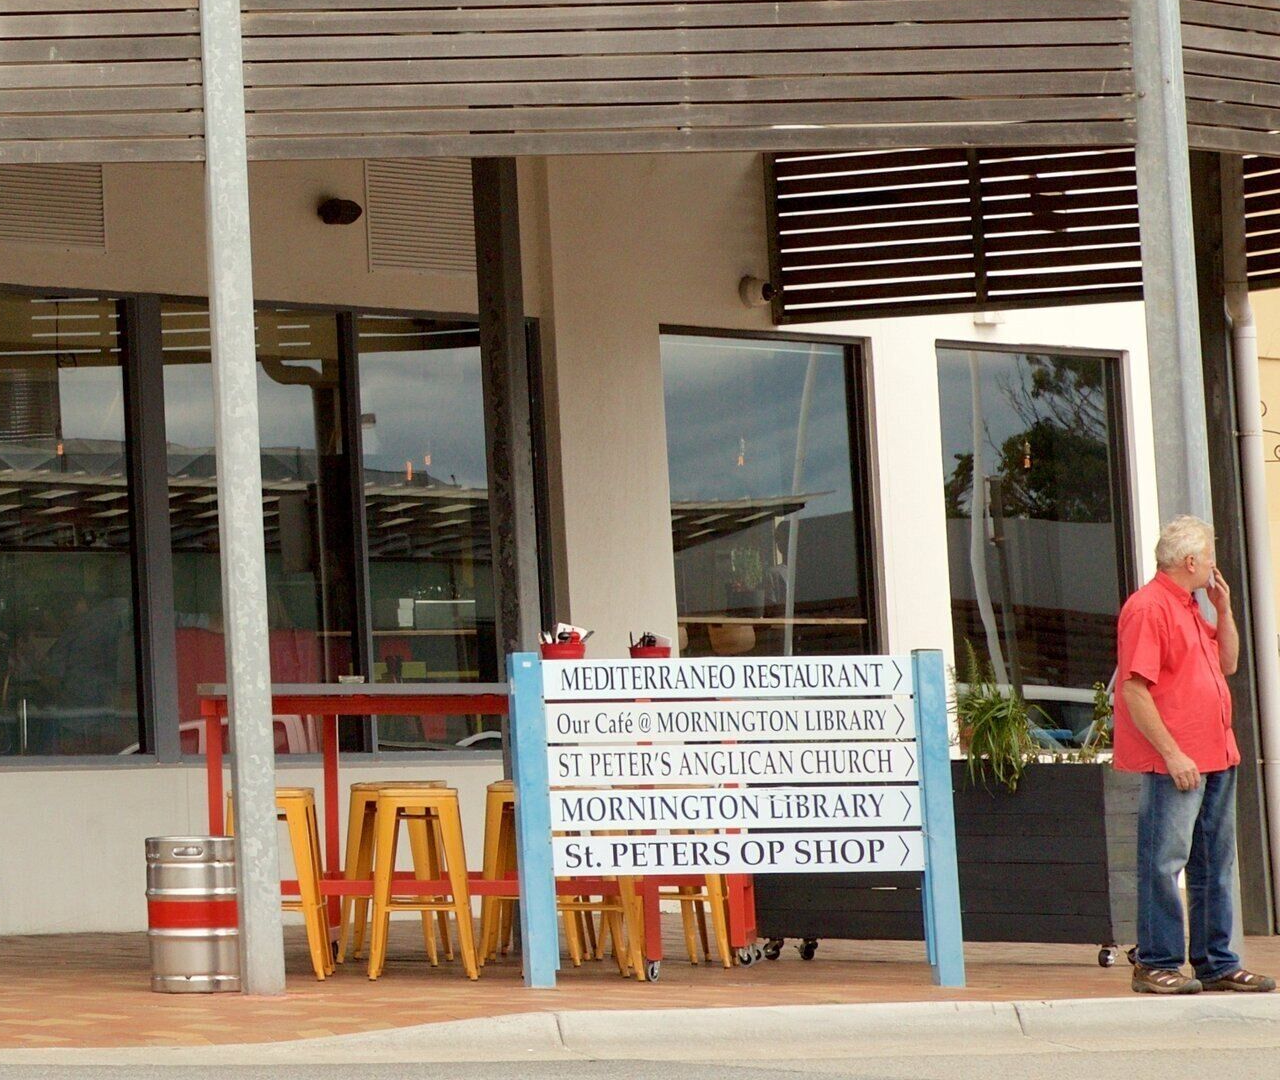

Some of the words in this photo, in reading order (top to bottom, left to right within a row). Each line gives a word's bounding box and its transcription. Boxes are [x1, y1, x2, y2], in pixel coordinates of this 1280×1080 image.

[560, 663, 736, 692] MEDITERRANEO
[743, 662, 884, 690] RESTAURANT
[557, 713, 590, 735] Our
[595, 711, 634, 735] Café
[638, 712, 653, 734] @
[657, 709, 799, 734] MORNINGTON
[805, 708, 888, 732] LIBRARY
[559, 751, 583, 778] ST
[590, 750, 672, 778] PETER'S
[679, 749, 794, 777] ANGLICAN
[800, 748, 894, 775] CHURCH
[560, 794, 760, 823] MORNINGTON
[565, 841, 602, 869] St.
[610, 840, 731, 867] PETERS
[740, 839, 786, 866] OP
[794, 838, 886, 865] SHOP
